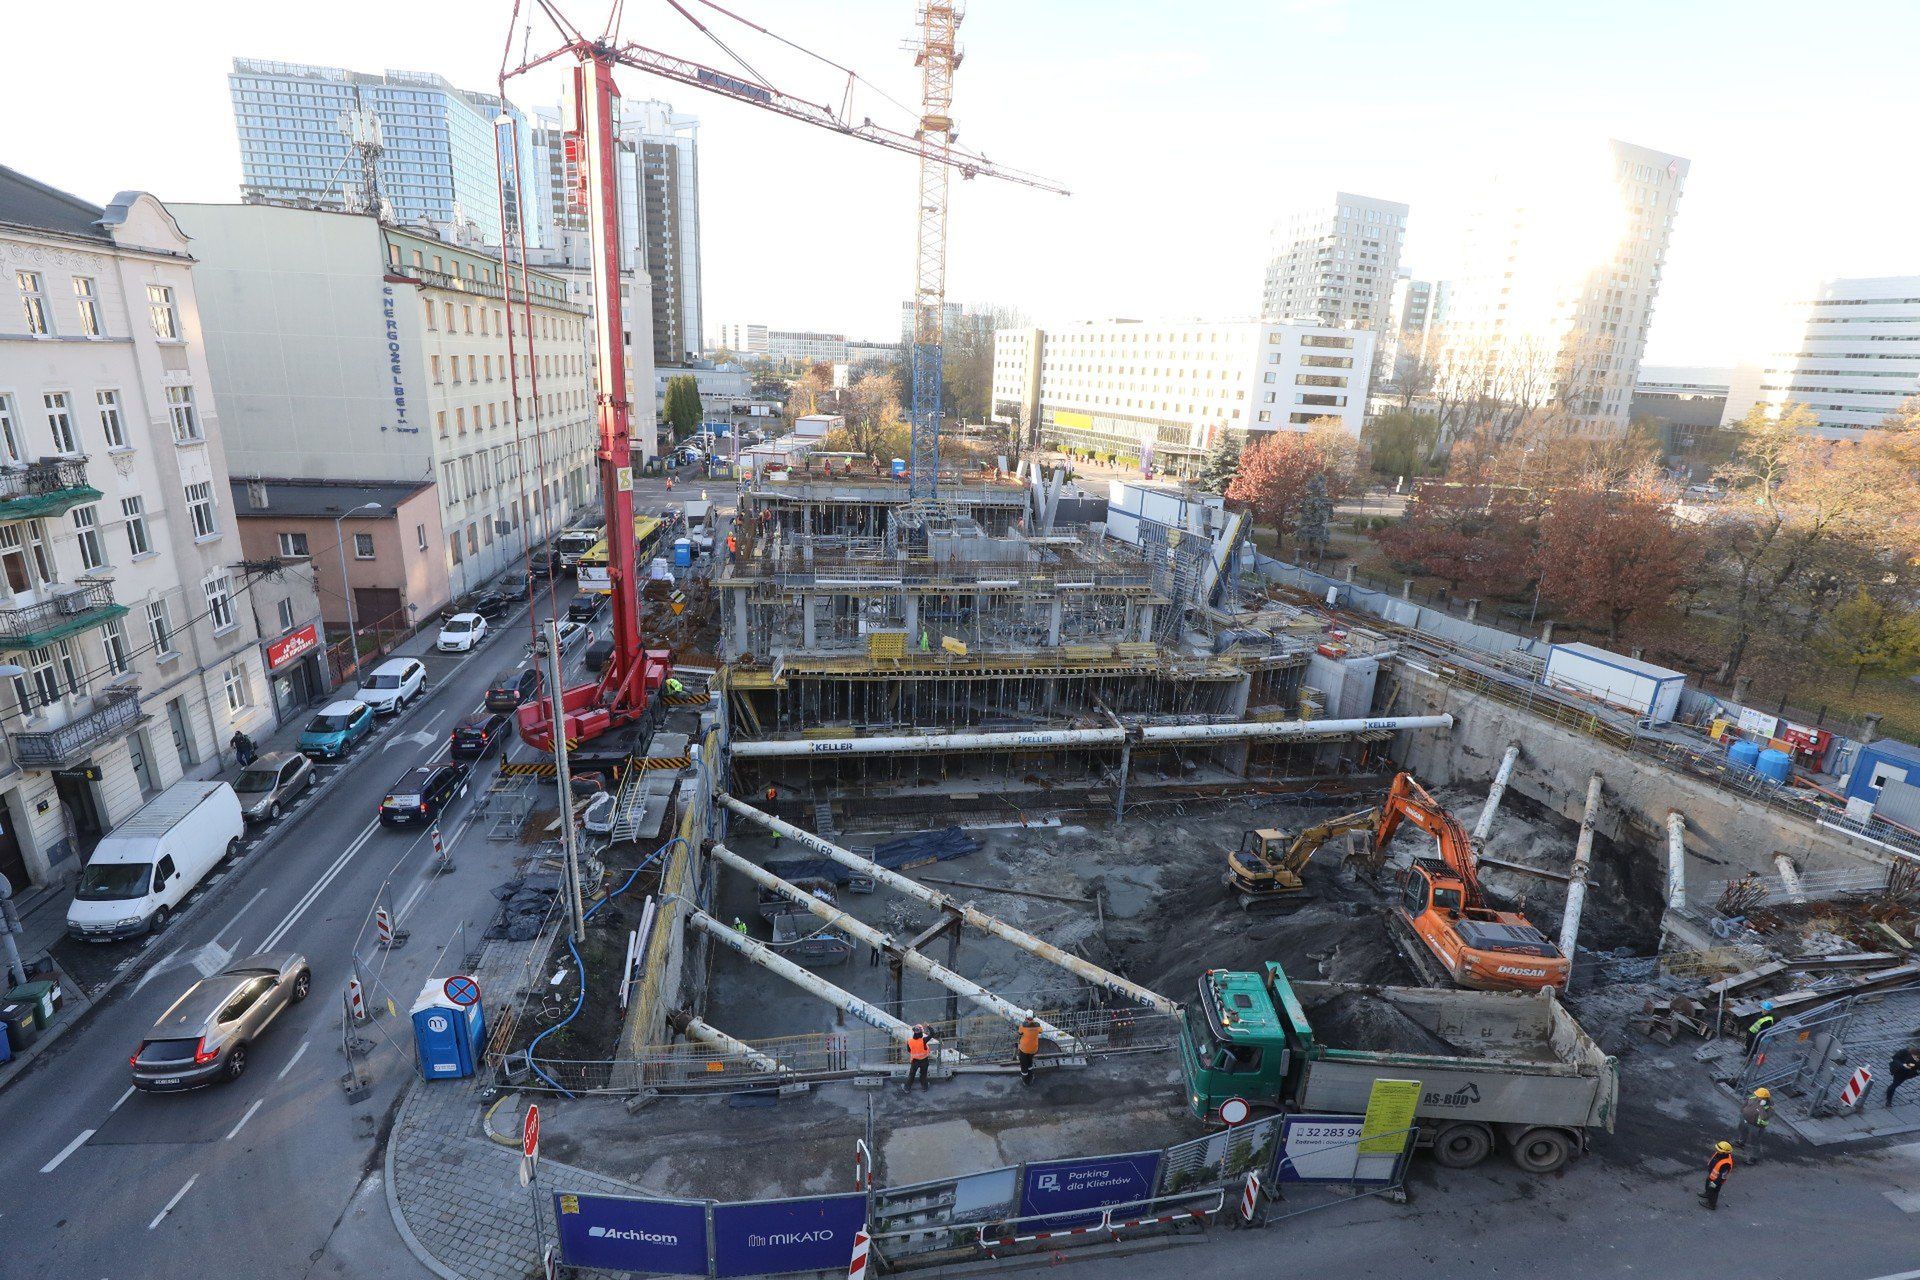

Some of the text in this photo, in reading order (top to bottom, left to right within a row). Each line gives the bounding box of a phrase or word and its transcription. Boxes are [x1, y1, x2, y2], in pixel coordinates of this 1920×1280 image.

[1210, 727, 1239, 736] KELLER
[1367, 721, 1397, 729] KELLER
[1021, 735, 1053, 744] KELLER
[814, 743, 853, 752] KELLER
[800, 835, 834, 857] KELLER
[777, 886, 809, 910] KELLER
[1497, 965, 1547, 977] DOOSAN
[1108, 981, 1157, 1008] KELLER
[1423, 1092, 1469, 1106] AS-BUD
[525, 1113, 537, 1149] STOP
[1306, 1127, 1320, 1137] 32
[1323, 1128, 1345, 1138] 283
[1068, 1169, 1110, 1180] Parking
[1066, 1176, 1132, 1191] dla Klientów
[604, 1228, 678, 1243] Archicom
[769, 1229, 834, 1245] MIKATO
